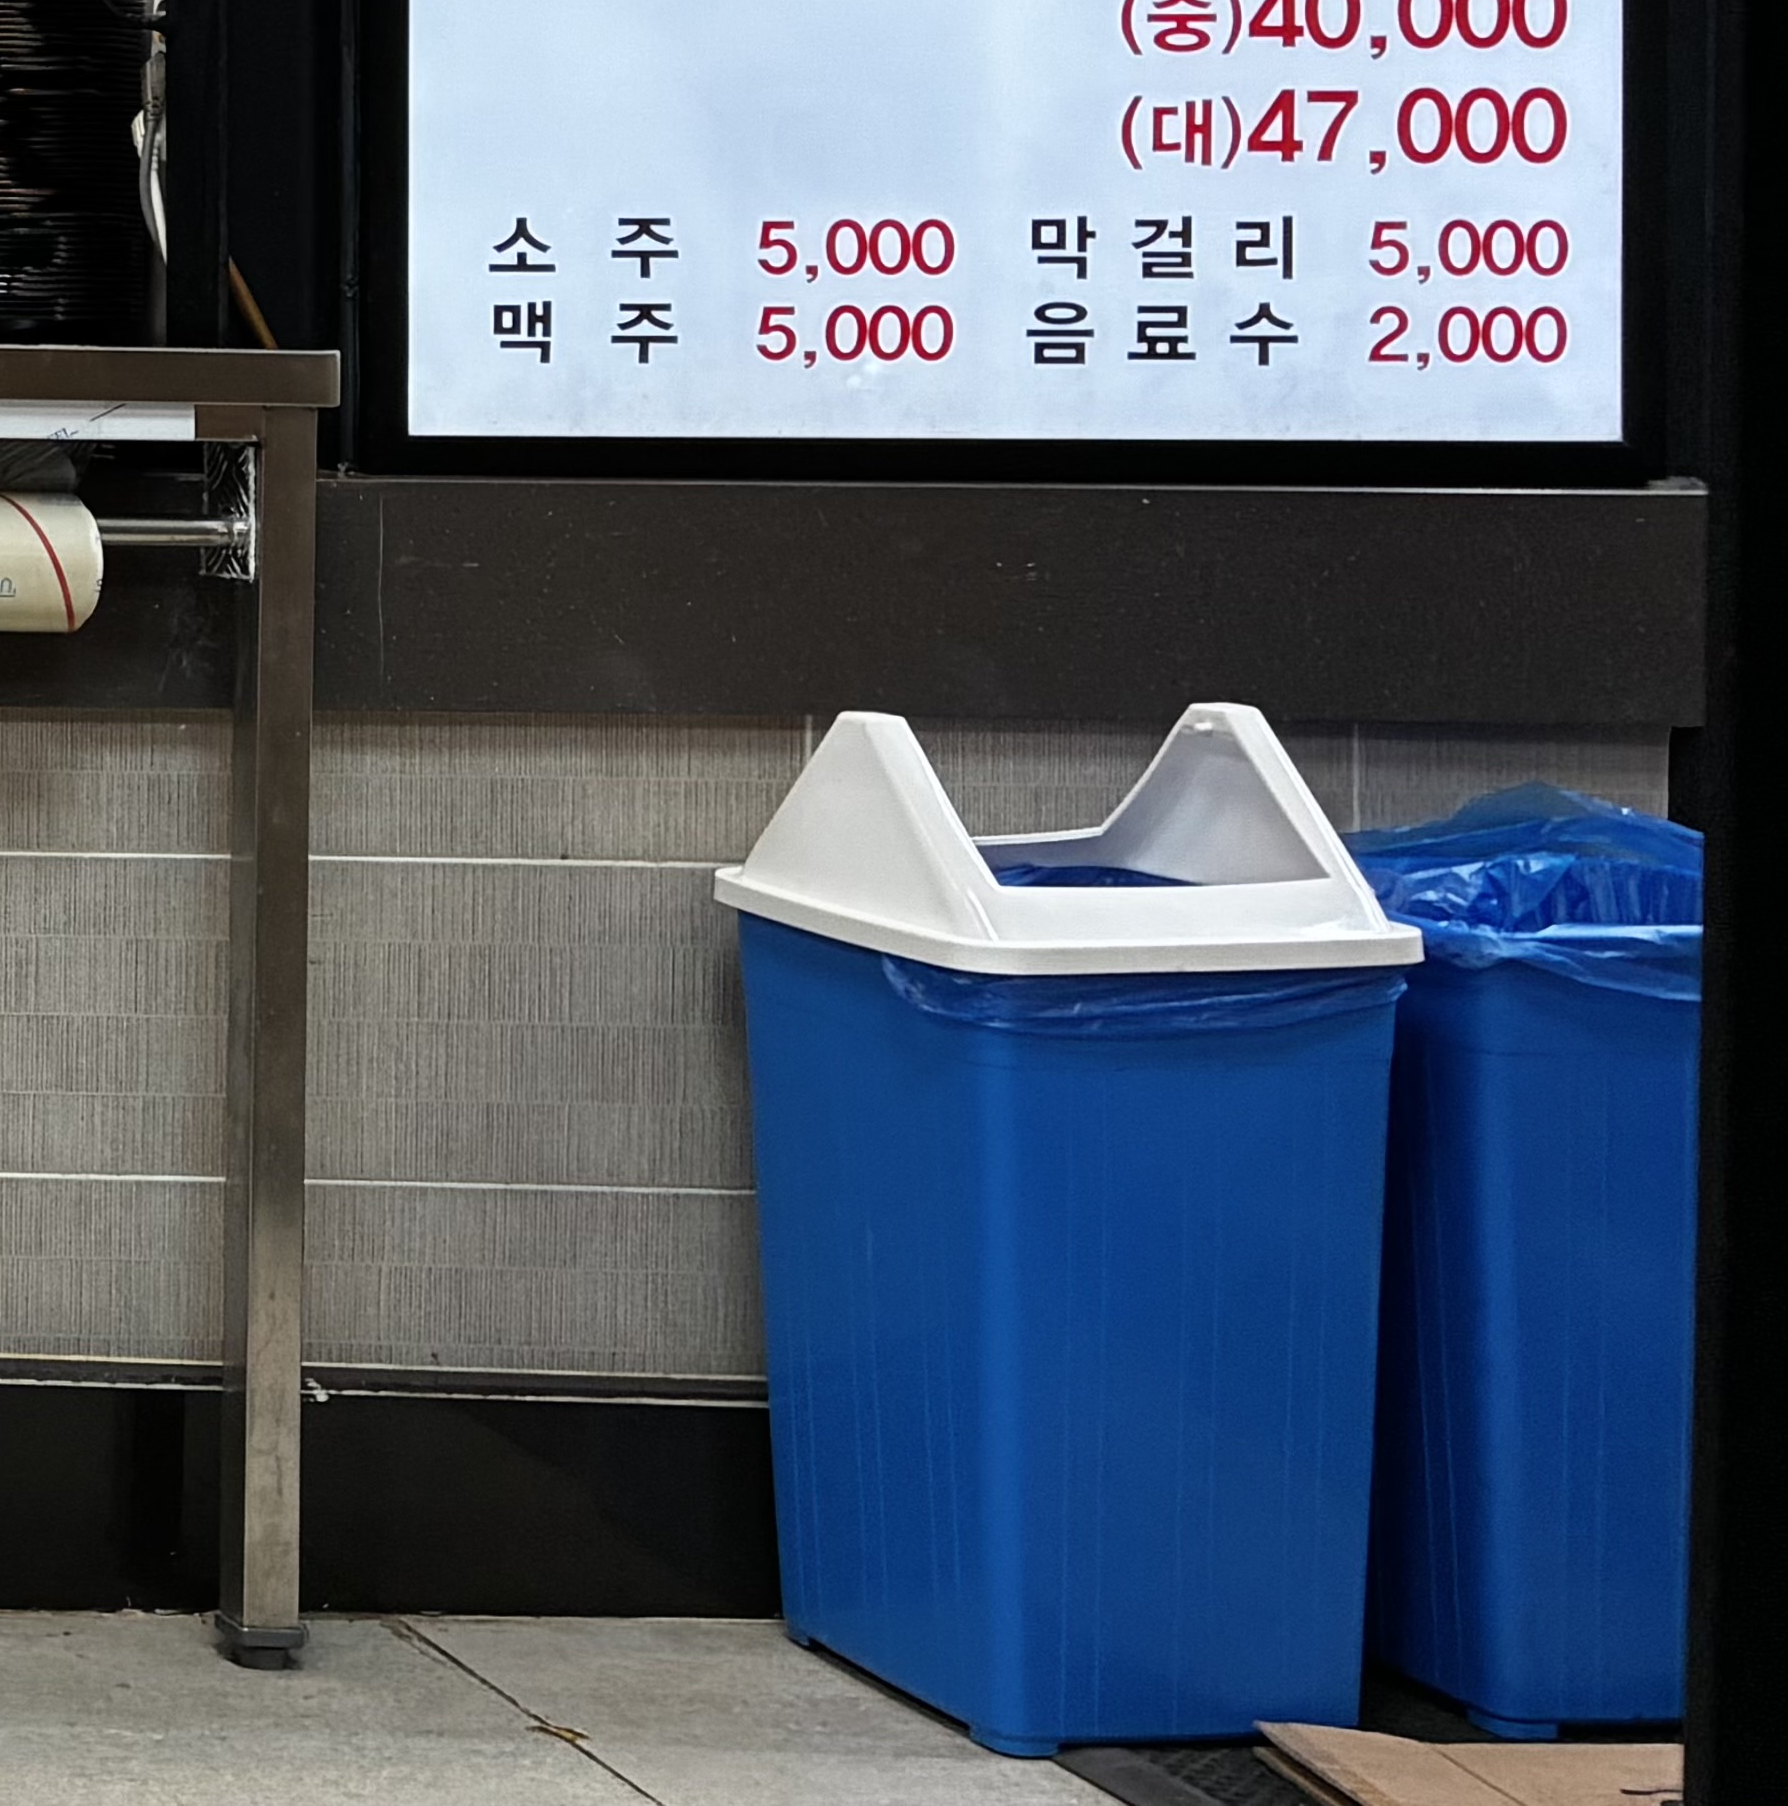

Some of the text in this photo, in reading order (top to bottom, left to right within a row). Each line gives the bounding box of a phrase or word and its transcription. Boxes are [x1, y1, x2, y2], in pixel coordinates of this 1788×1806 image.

[757, 219, 955, 284] 5,000
[1369, 219, 1569, 284] 5,000
[756, 304, 954, 369] 5,000
[1368, 305, 1567, 371] 2,000
